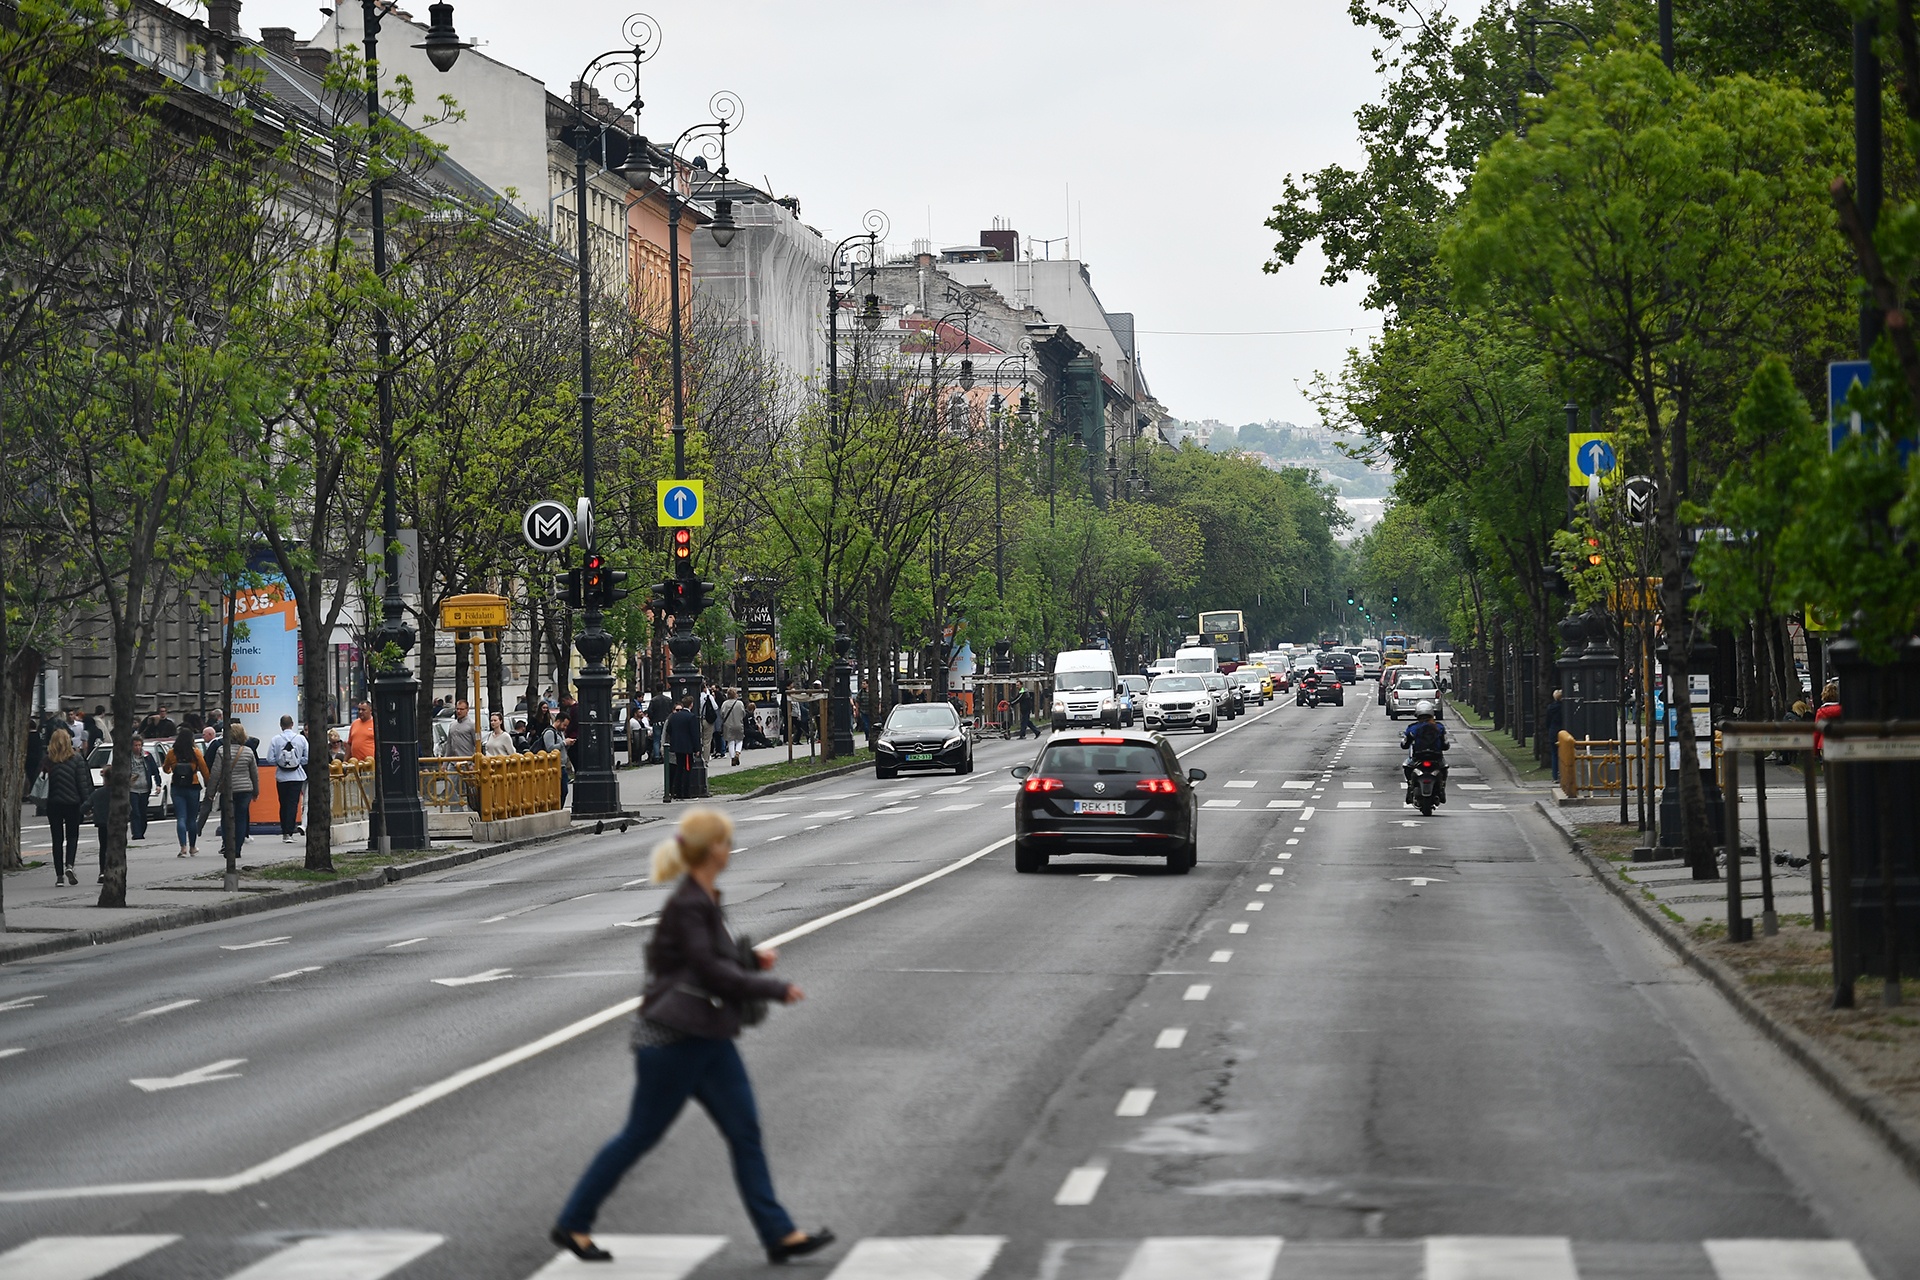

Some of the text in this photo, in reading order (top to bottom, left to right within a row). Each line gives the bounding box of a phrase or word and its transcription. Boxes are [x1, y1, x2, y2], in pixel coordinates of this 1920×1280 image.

[534, 512, 561, 539] M
[231, 646, 261, 655] zelnek:
[235, 688, 260, 699] KELL
[1082, 802, 1123, 811] REK-115
